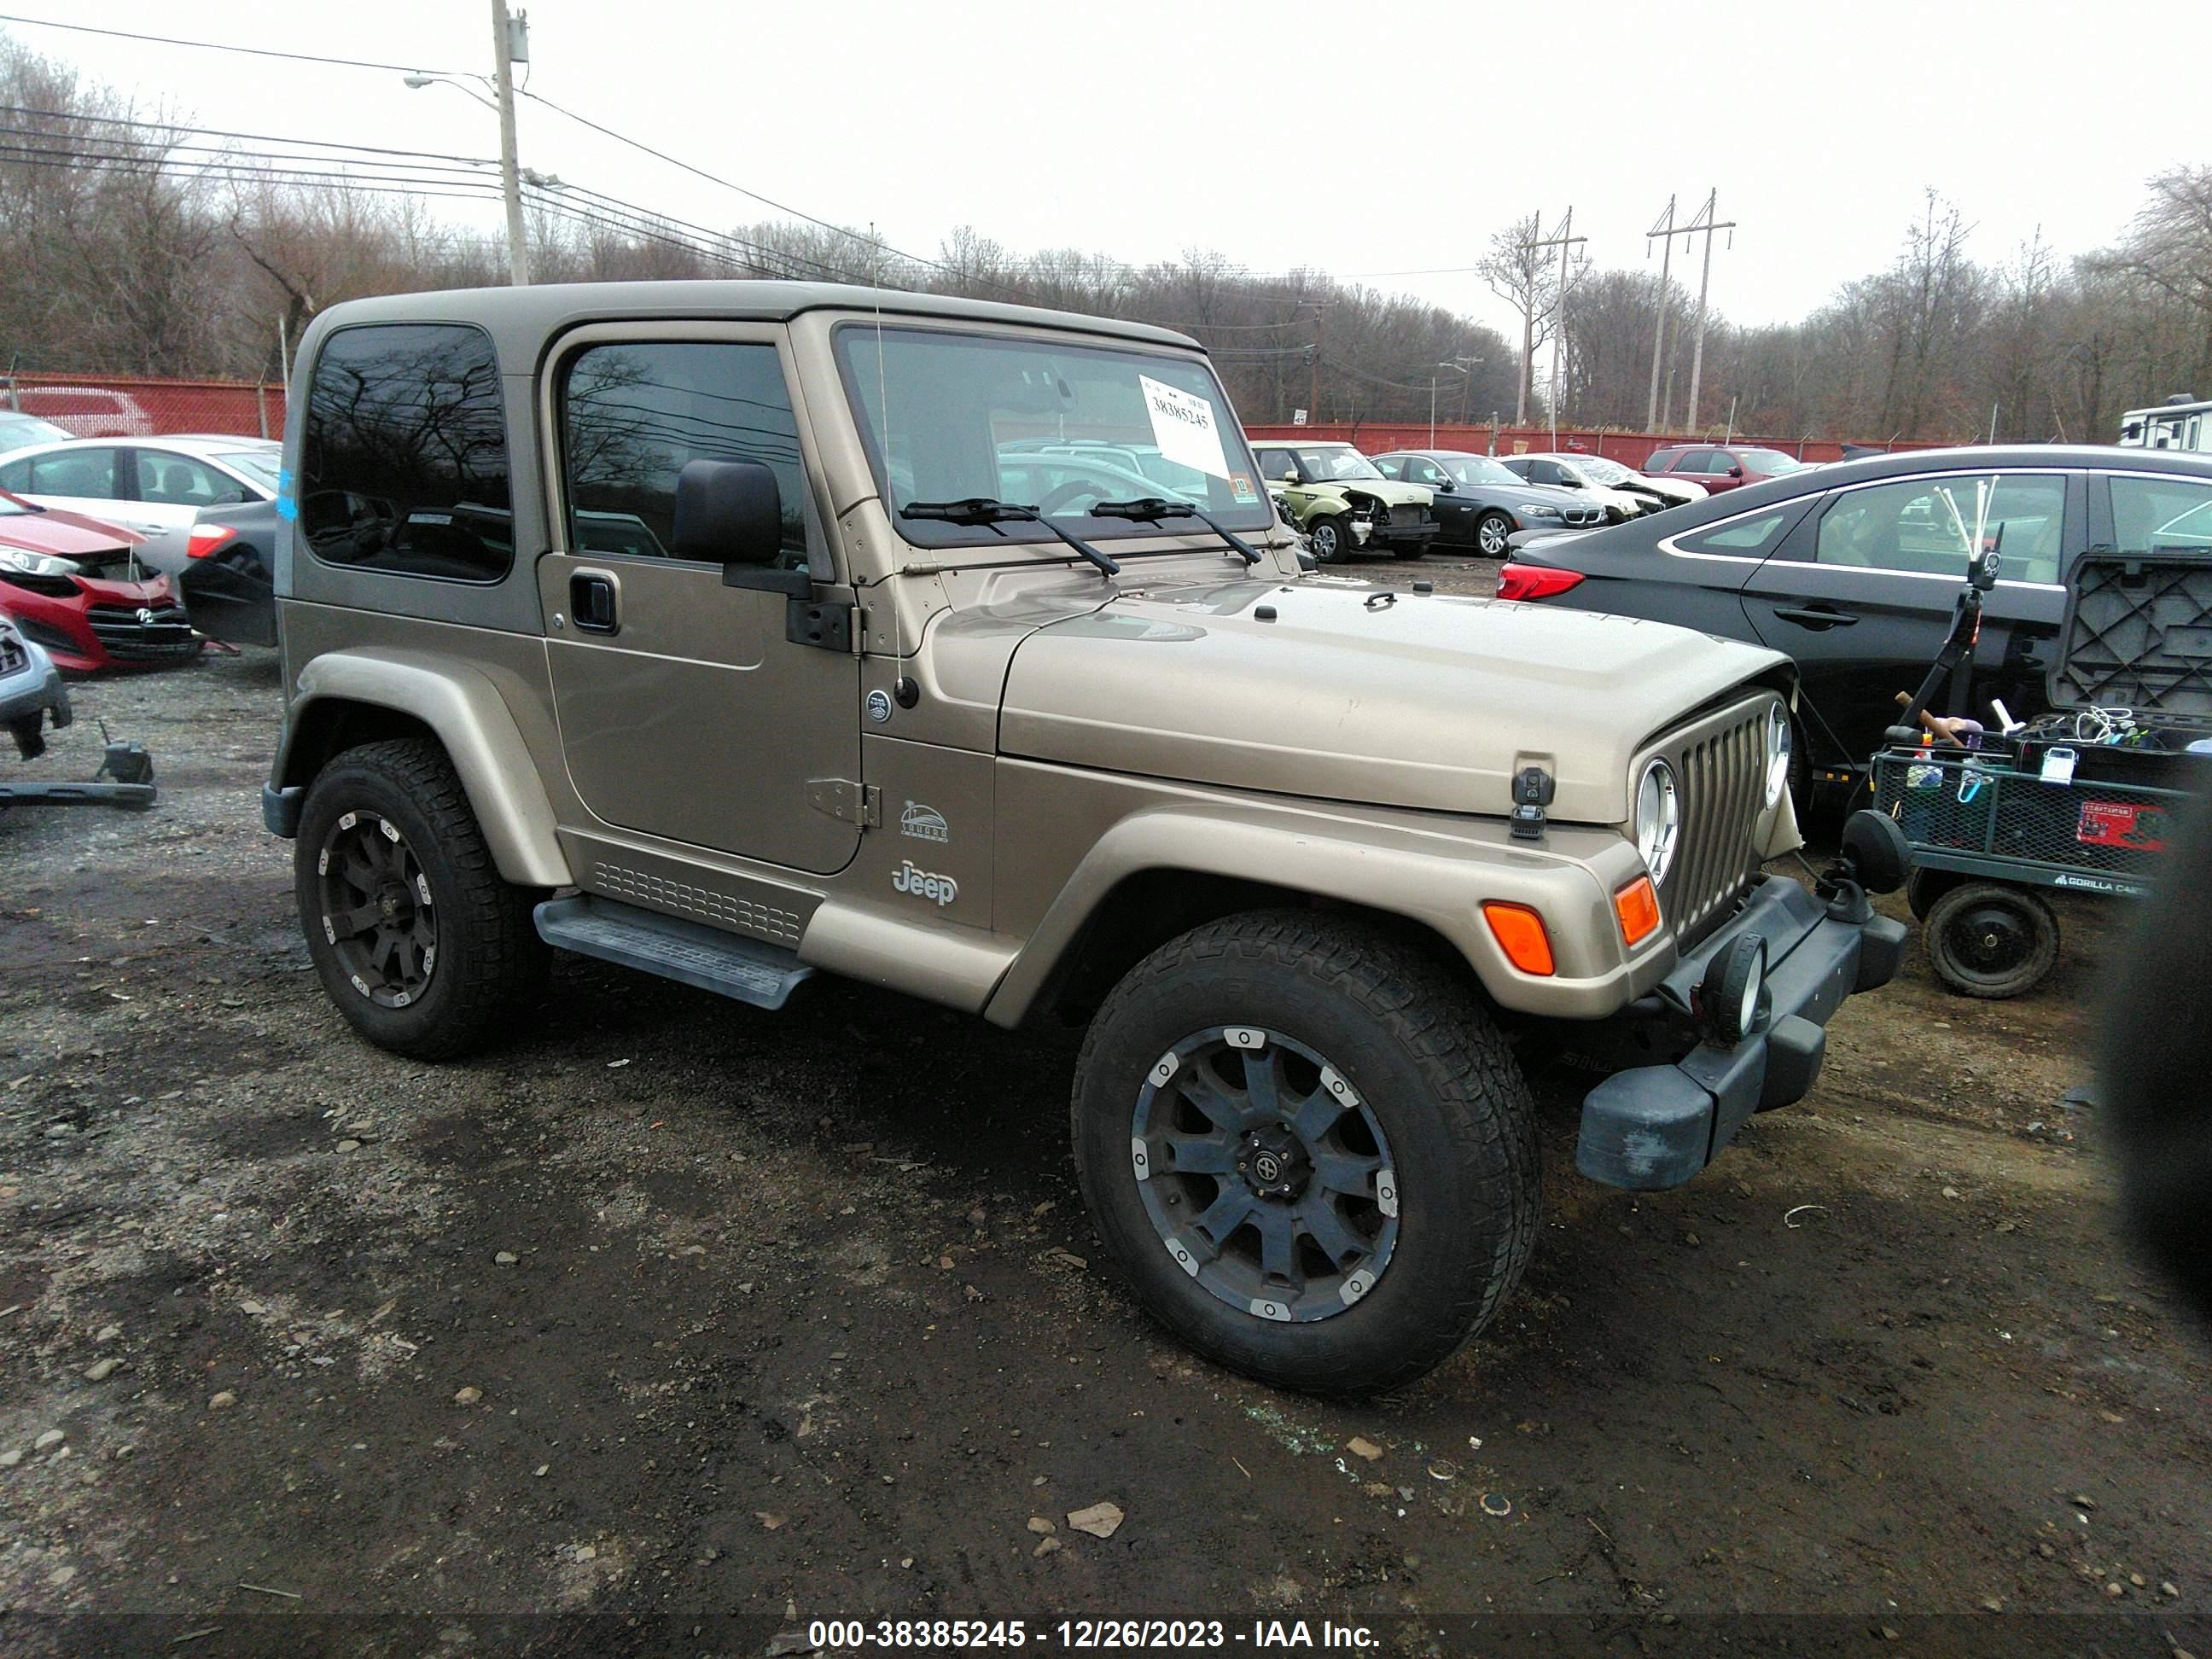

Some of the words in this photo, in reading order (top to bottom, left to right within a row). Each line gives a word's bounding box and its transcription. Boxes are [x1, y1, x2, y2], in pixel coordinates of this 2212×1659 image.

[1153, 396, 1208, 429] 38385245
[902, 823, 947, 838] SAHARA
[892, 859, 958, 906] Jeep
[2069, 877, 2113, 892] GORILLA
